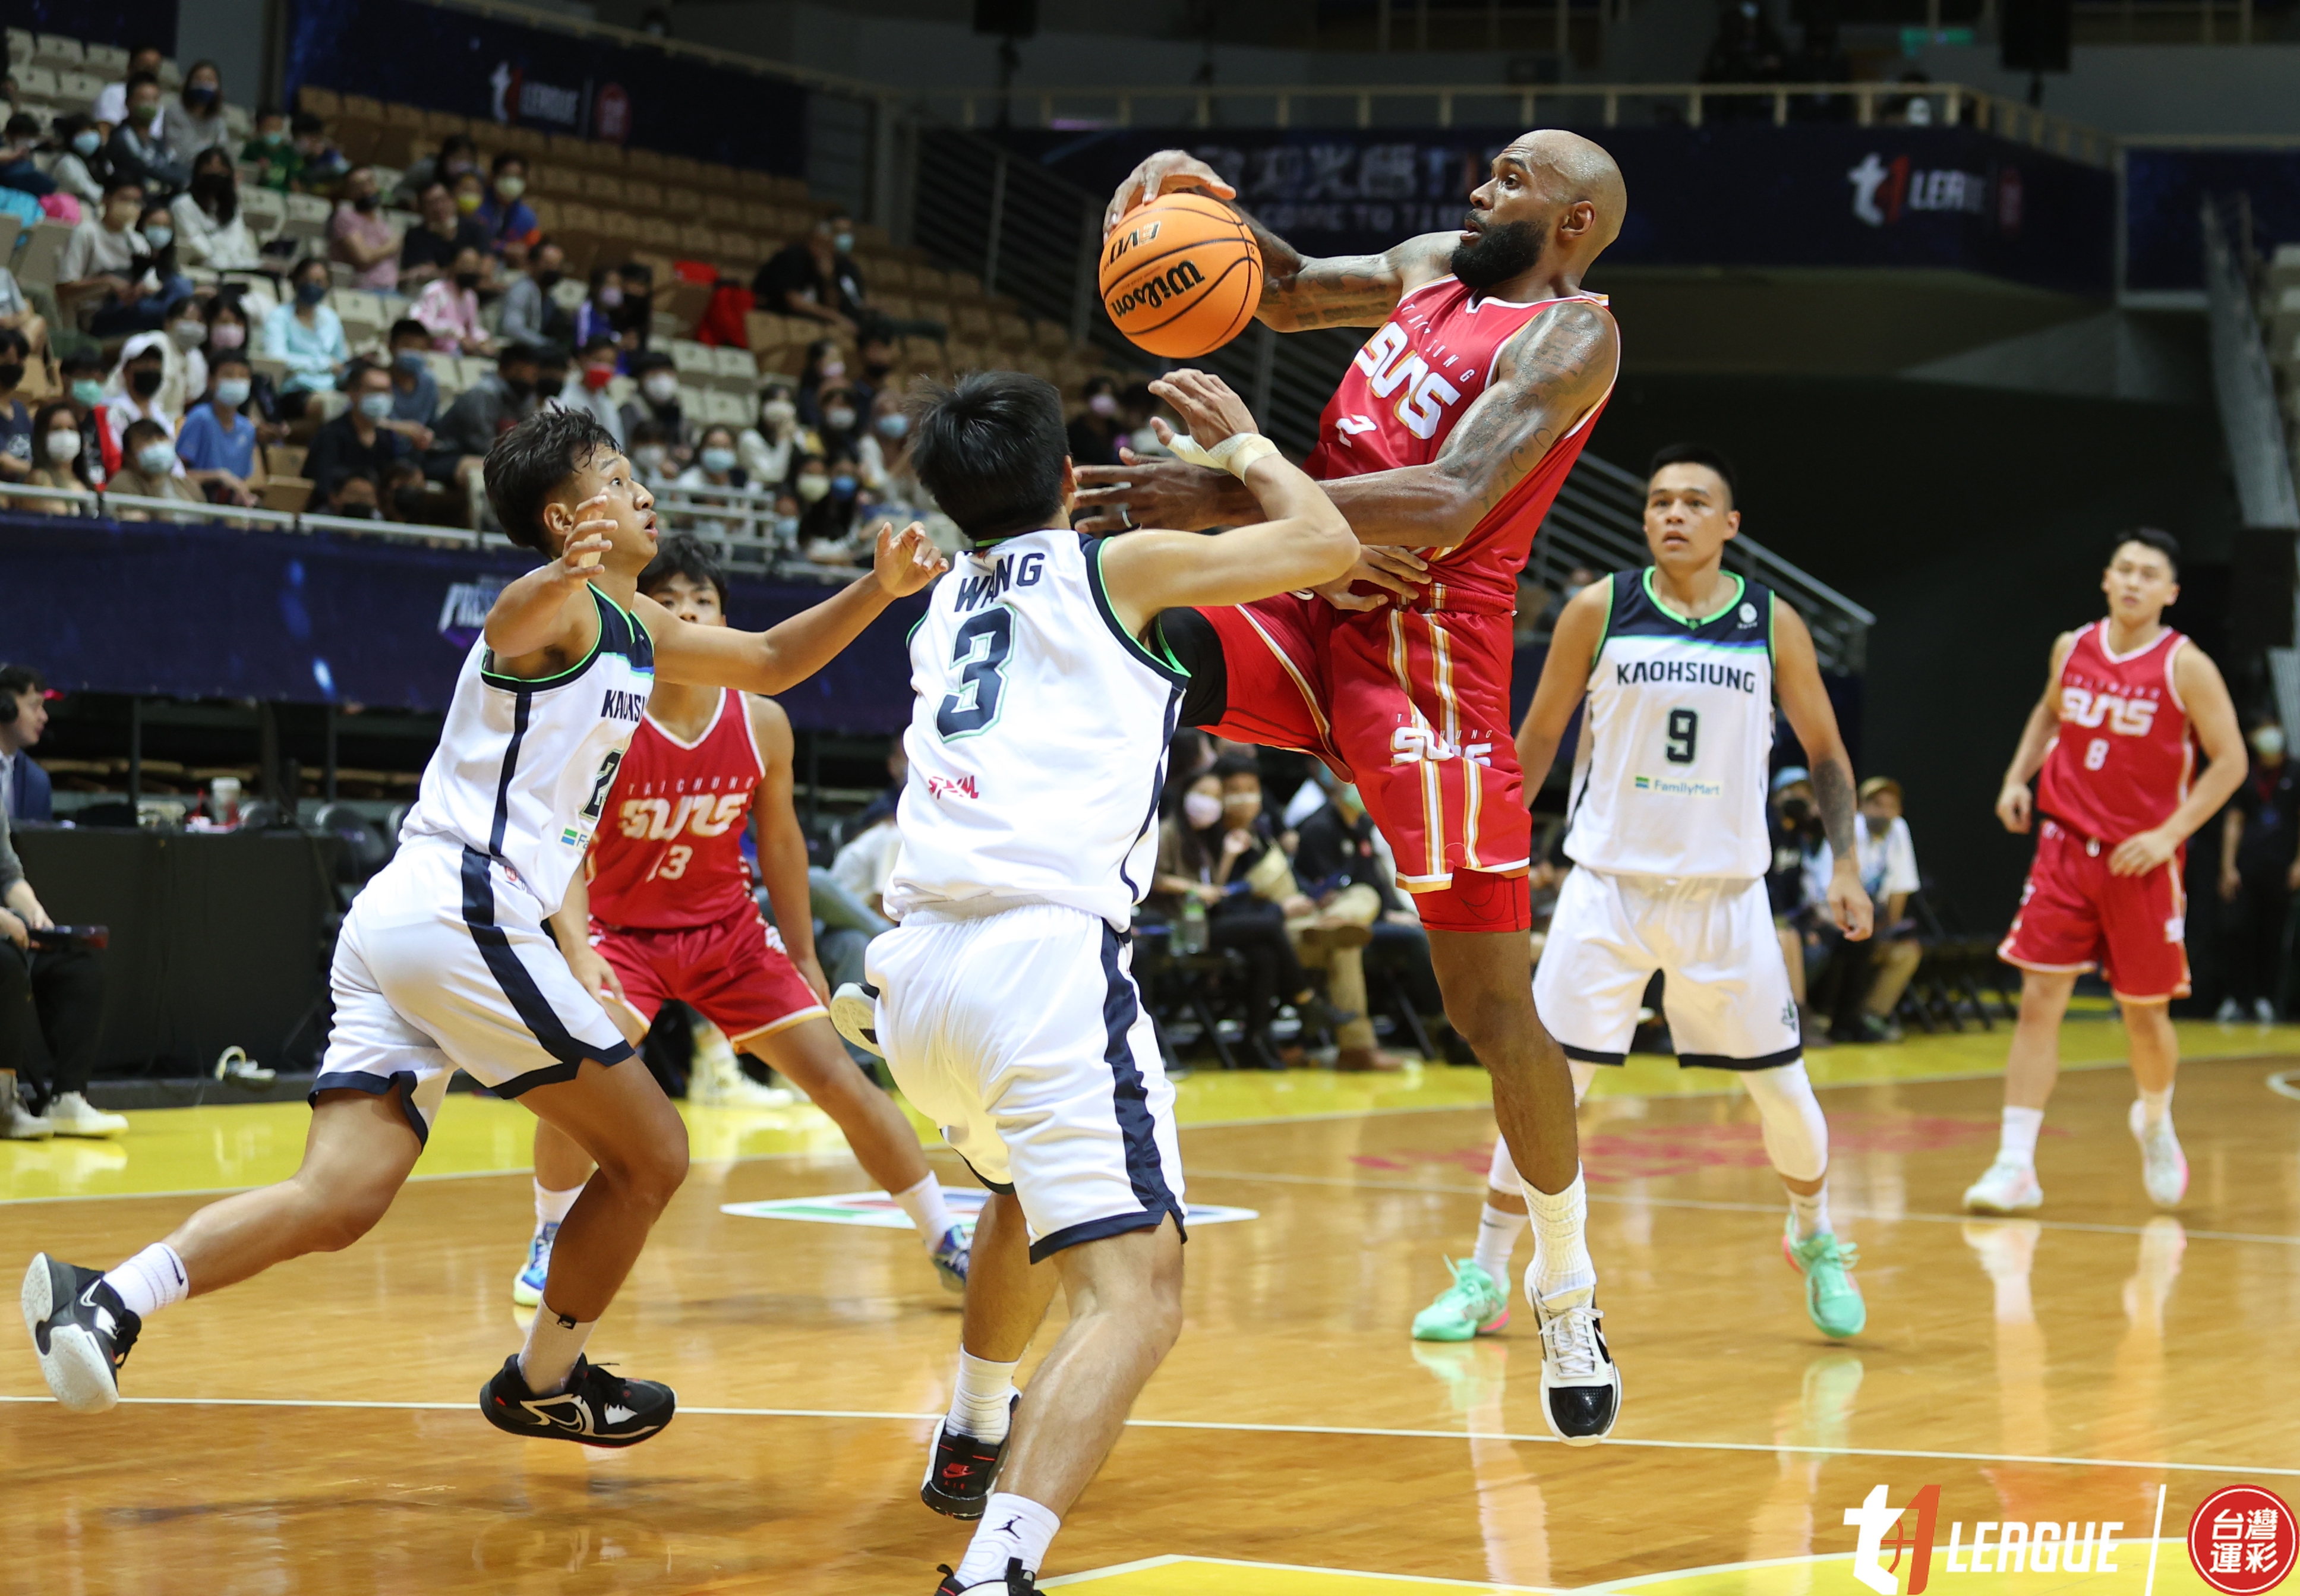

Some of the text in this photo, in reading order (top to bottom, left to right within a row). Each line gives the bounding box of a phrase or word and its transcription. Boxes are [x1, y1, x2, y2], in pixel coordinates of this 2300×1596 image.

[1110, 260, 1206, 318] Wilson
[1336, 414, 1377, 448] 2
[954, 553, 1045, 613] WANG
[934, 603, 1017, 744] 3
[1617, 661, 1755, 693] KAOHSIUNG
[1665, 708, 1699, 765] 9
[2084, 737, 2110, 771] 8
[1655, 780, 1720, 796] FamilyMart
